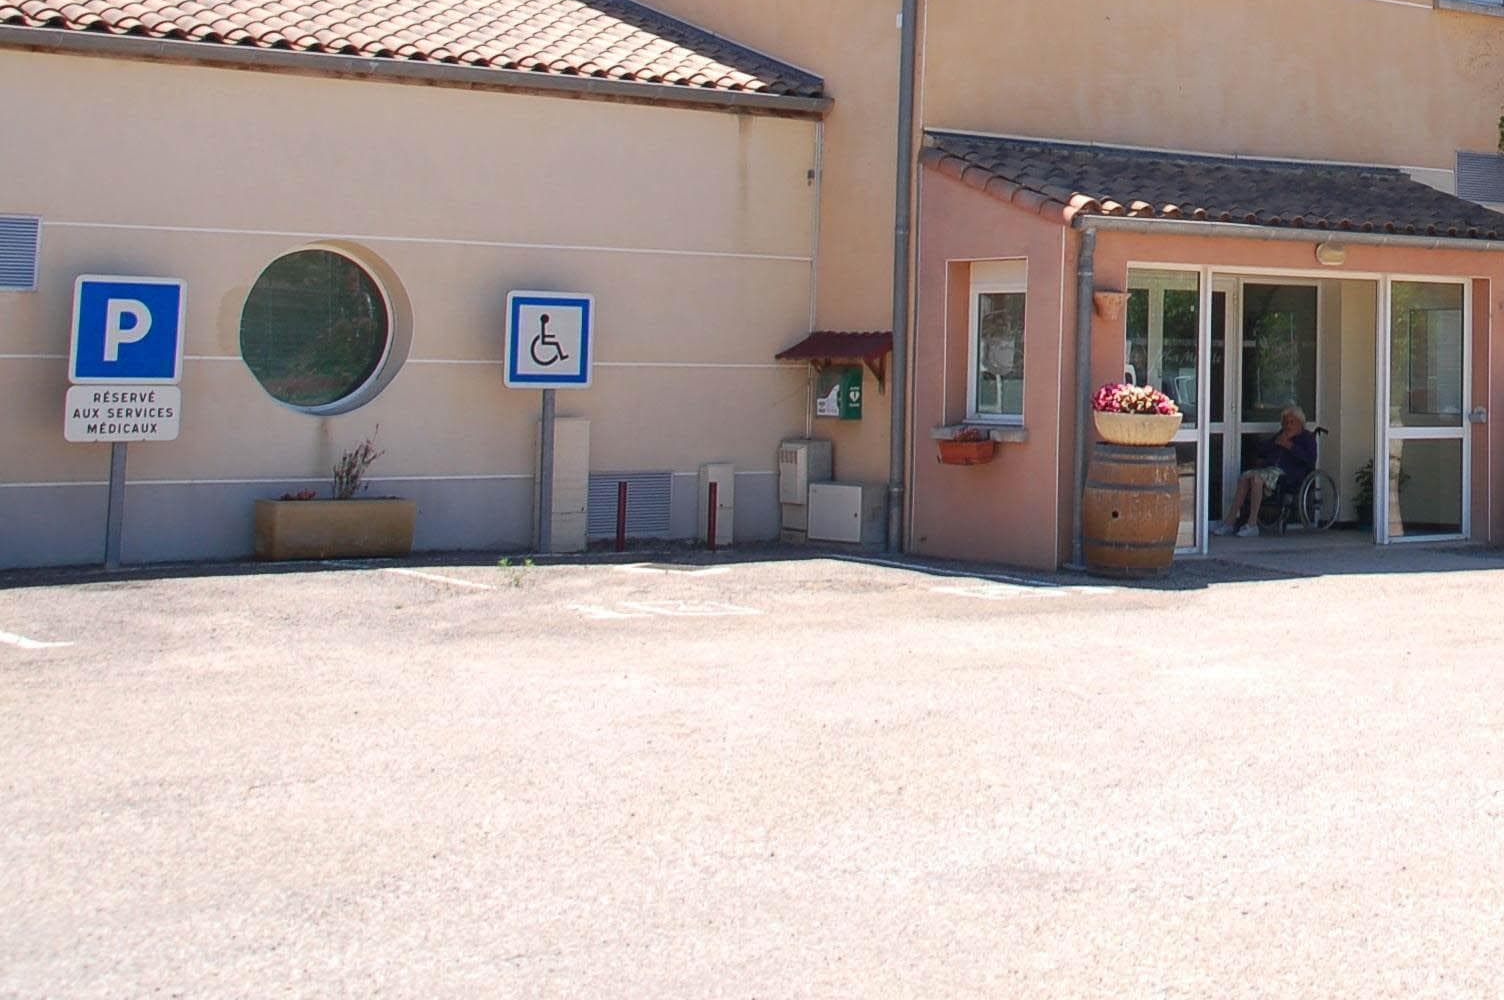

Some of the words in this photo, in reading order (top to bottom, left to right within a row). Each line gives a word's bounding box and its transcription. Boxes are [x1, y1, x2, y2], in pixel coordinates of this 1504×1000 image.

[103, 298, 153, 362] P
[93, 390, 156, 403] RÉSERVÉ
[73, 408, 100, 419] AUX
[107, 407, 174, 418] SERVICES
[86, 421, 158, 434] MÉDICAUX
